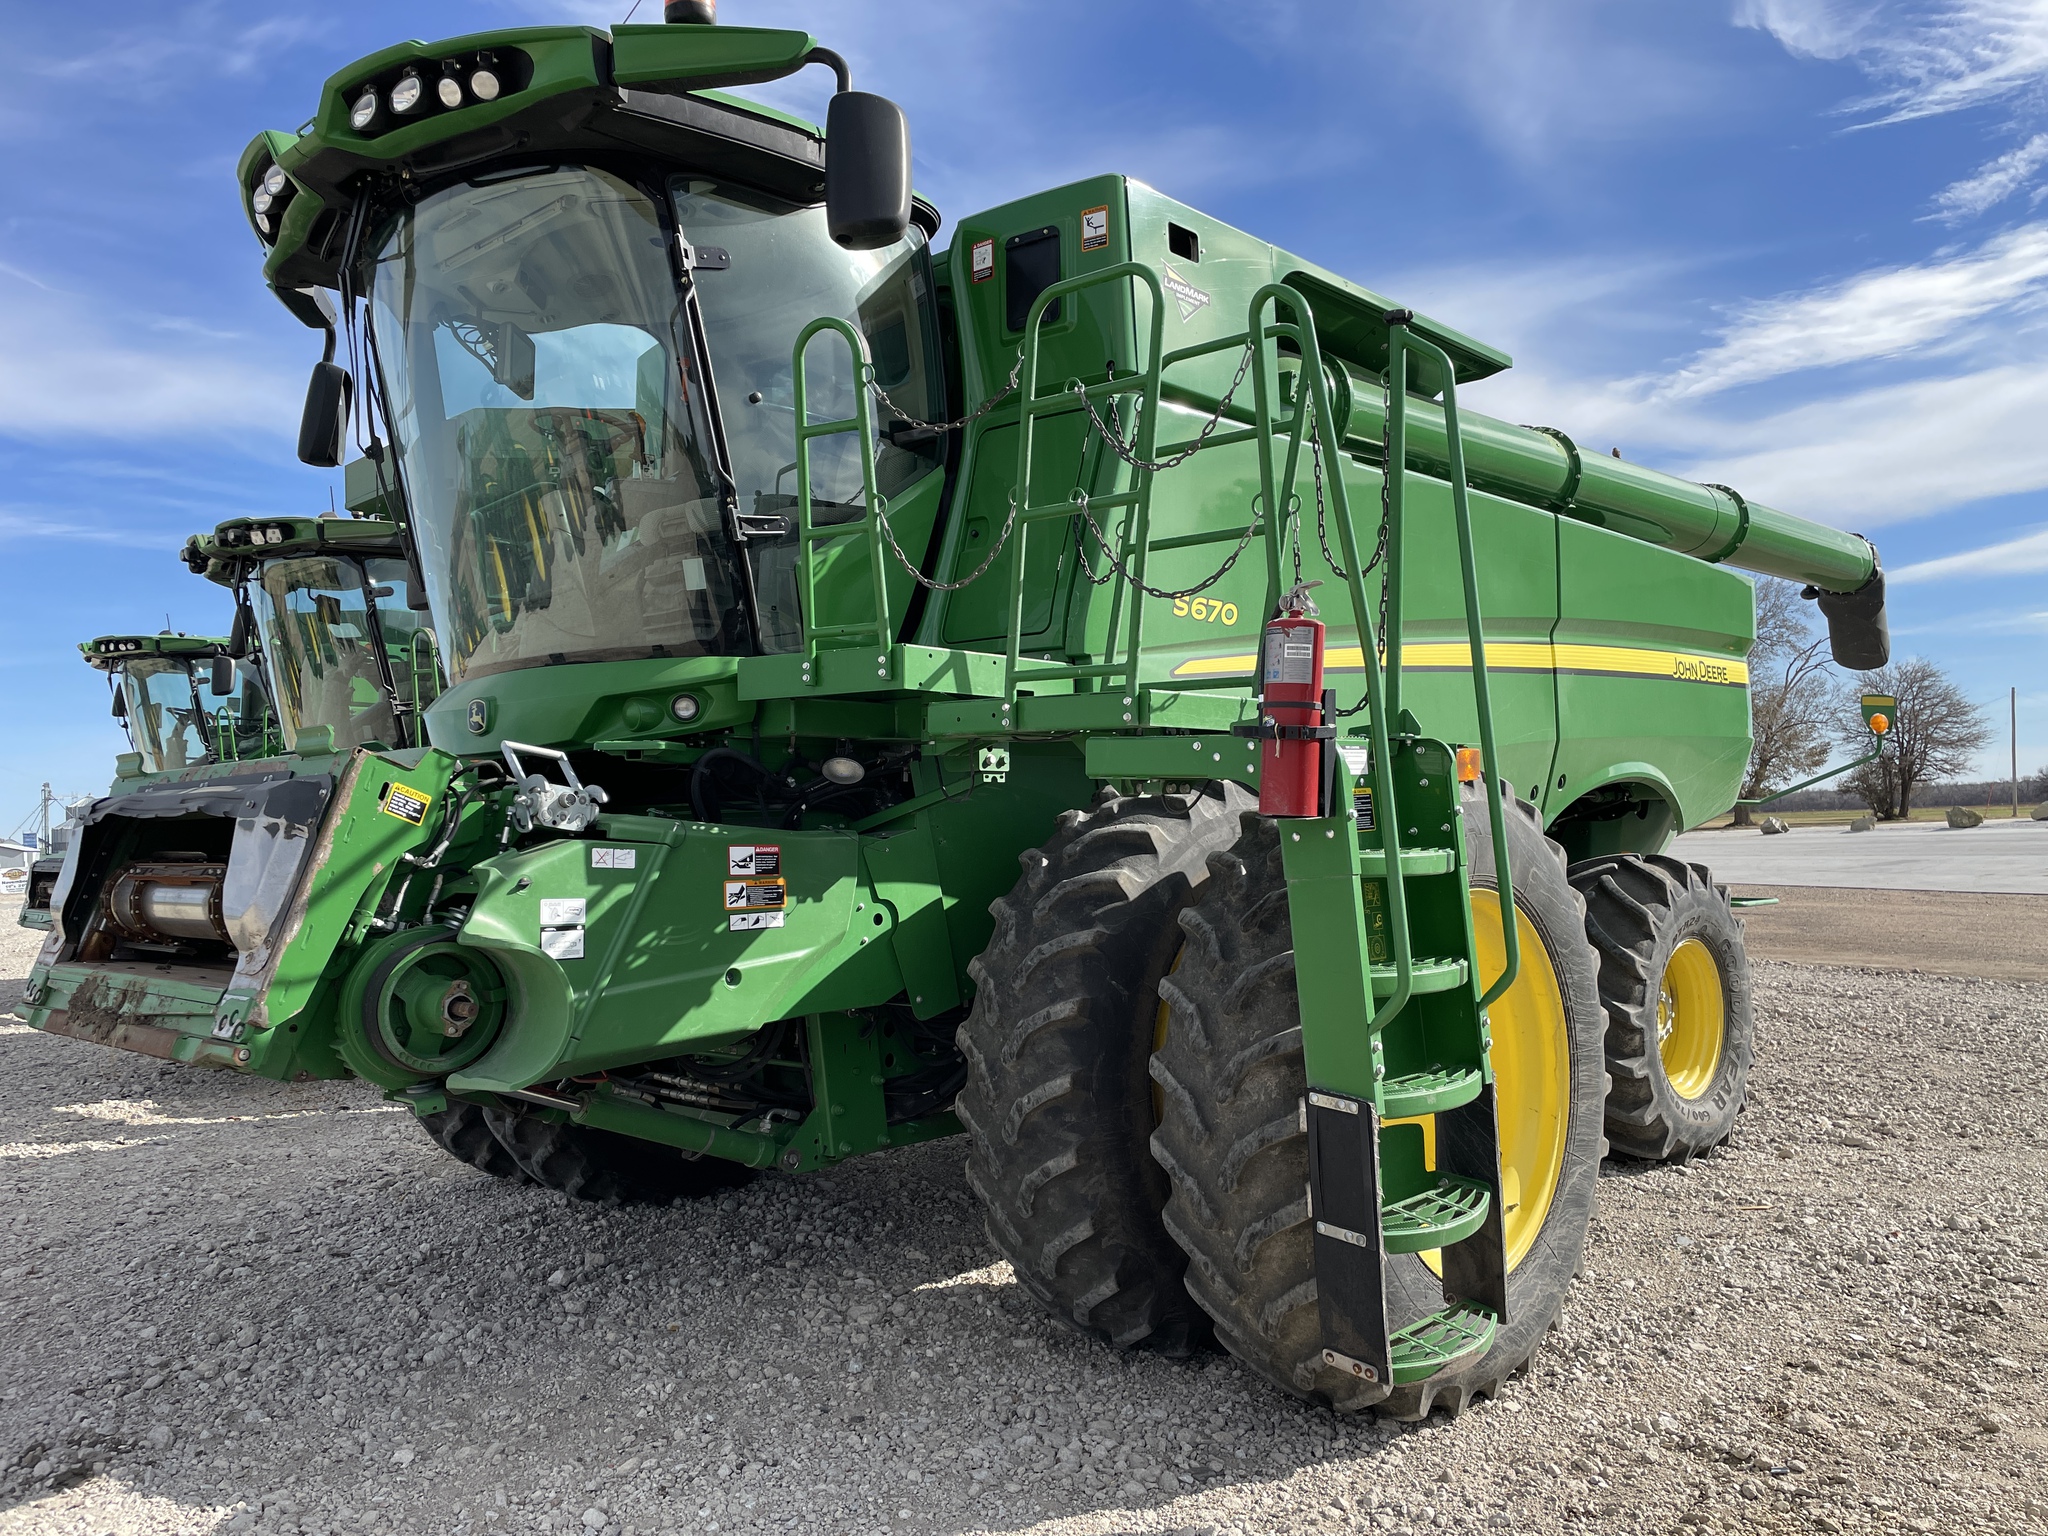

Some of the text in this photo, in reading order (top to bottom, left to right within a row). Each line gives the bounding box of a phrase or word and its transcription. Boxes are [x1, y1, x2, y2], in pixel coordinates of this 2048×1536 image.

[1173, 593, 1239, 626] S670
[1673, 657, 1729, 681] JOHN DEERE
[399, 785, 430, 803] CAUTION
[1711, 938, 1743, 1112] GOODYEAR
